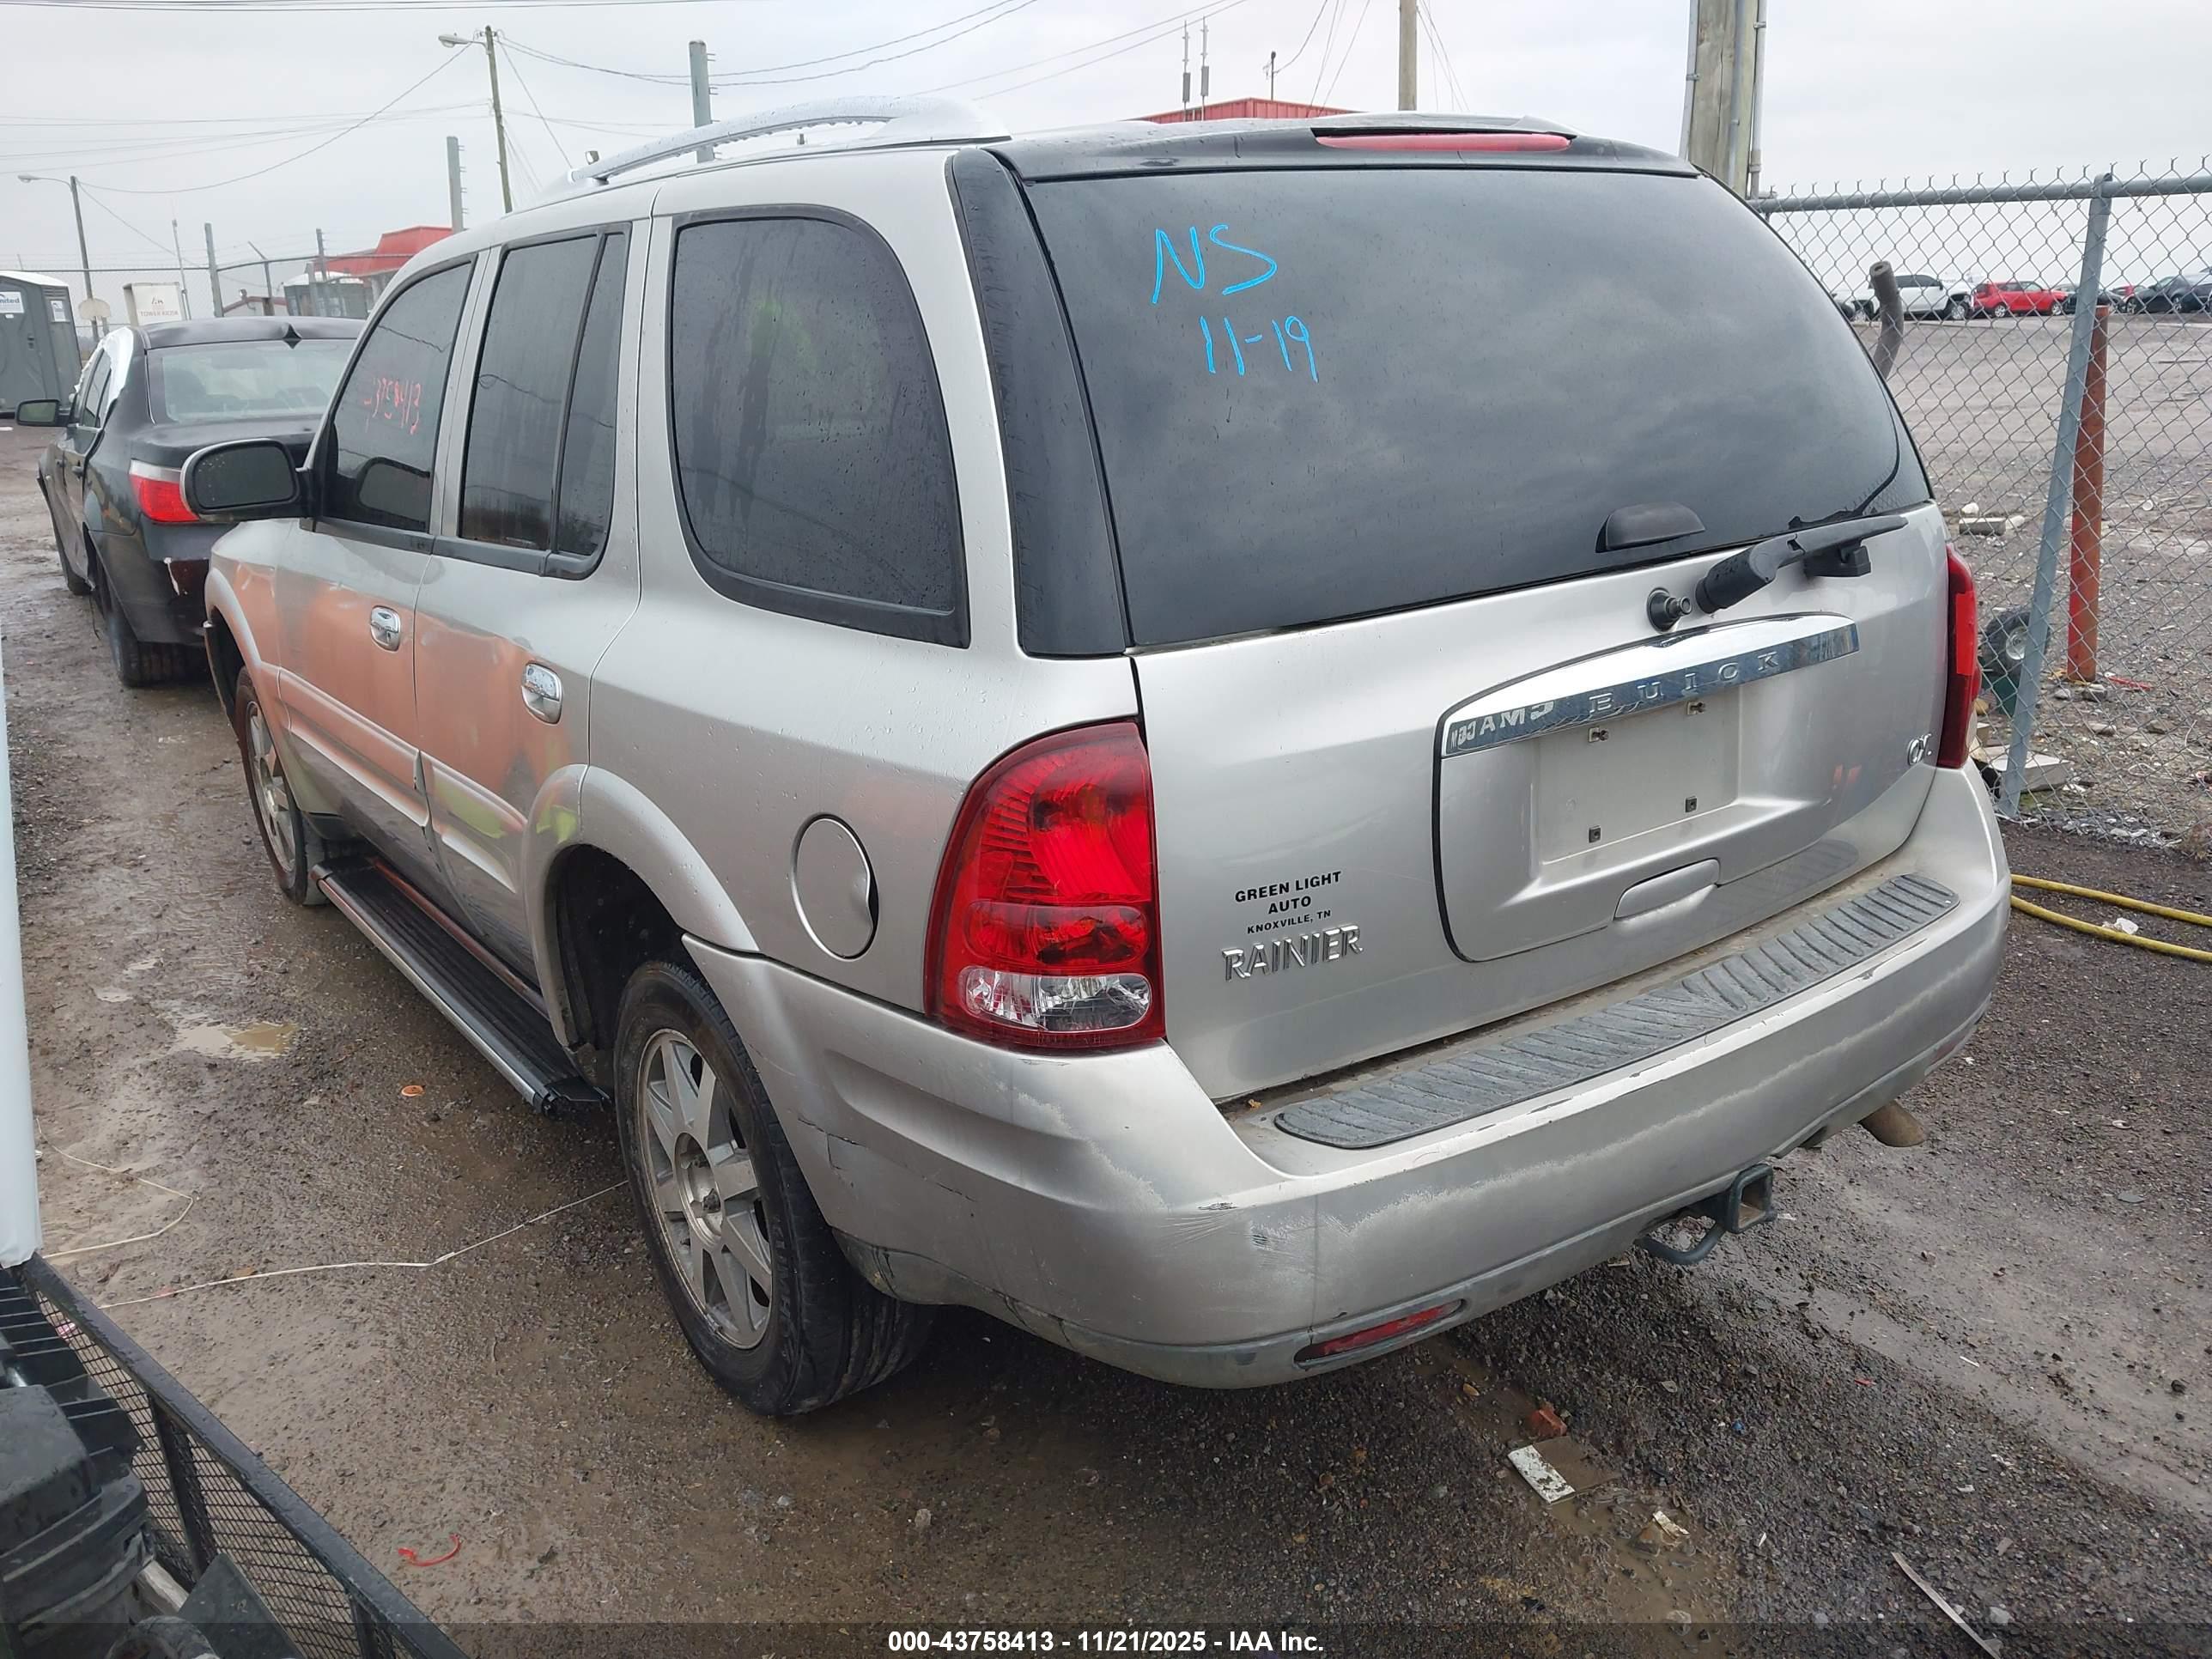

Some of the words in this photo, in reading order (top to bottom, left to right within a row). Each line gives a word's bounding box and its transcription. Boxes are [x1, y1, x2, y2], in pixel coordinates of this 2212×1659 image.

[1151, 224, 1277, 304] NS
[1199, 315, 1318, 383] 11-19
[1589, 651, 1779, 714] BUICK
[1235, 882, 1290, 902] GREEN
[1295, 871, 1341, 891] LIGHT
[1267, 896, 1312, 915] AUTO
[1247, 914, 1314, 934] KNOXVILLE,
[1316, 909, 1332, 920] TN
[1221, 925, 1364, 981] RAINIER
